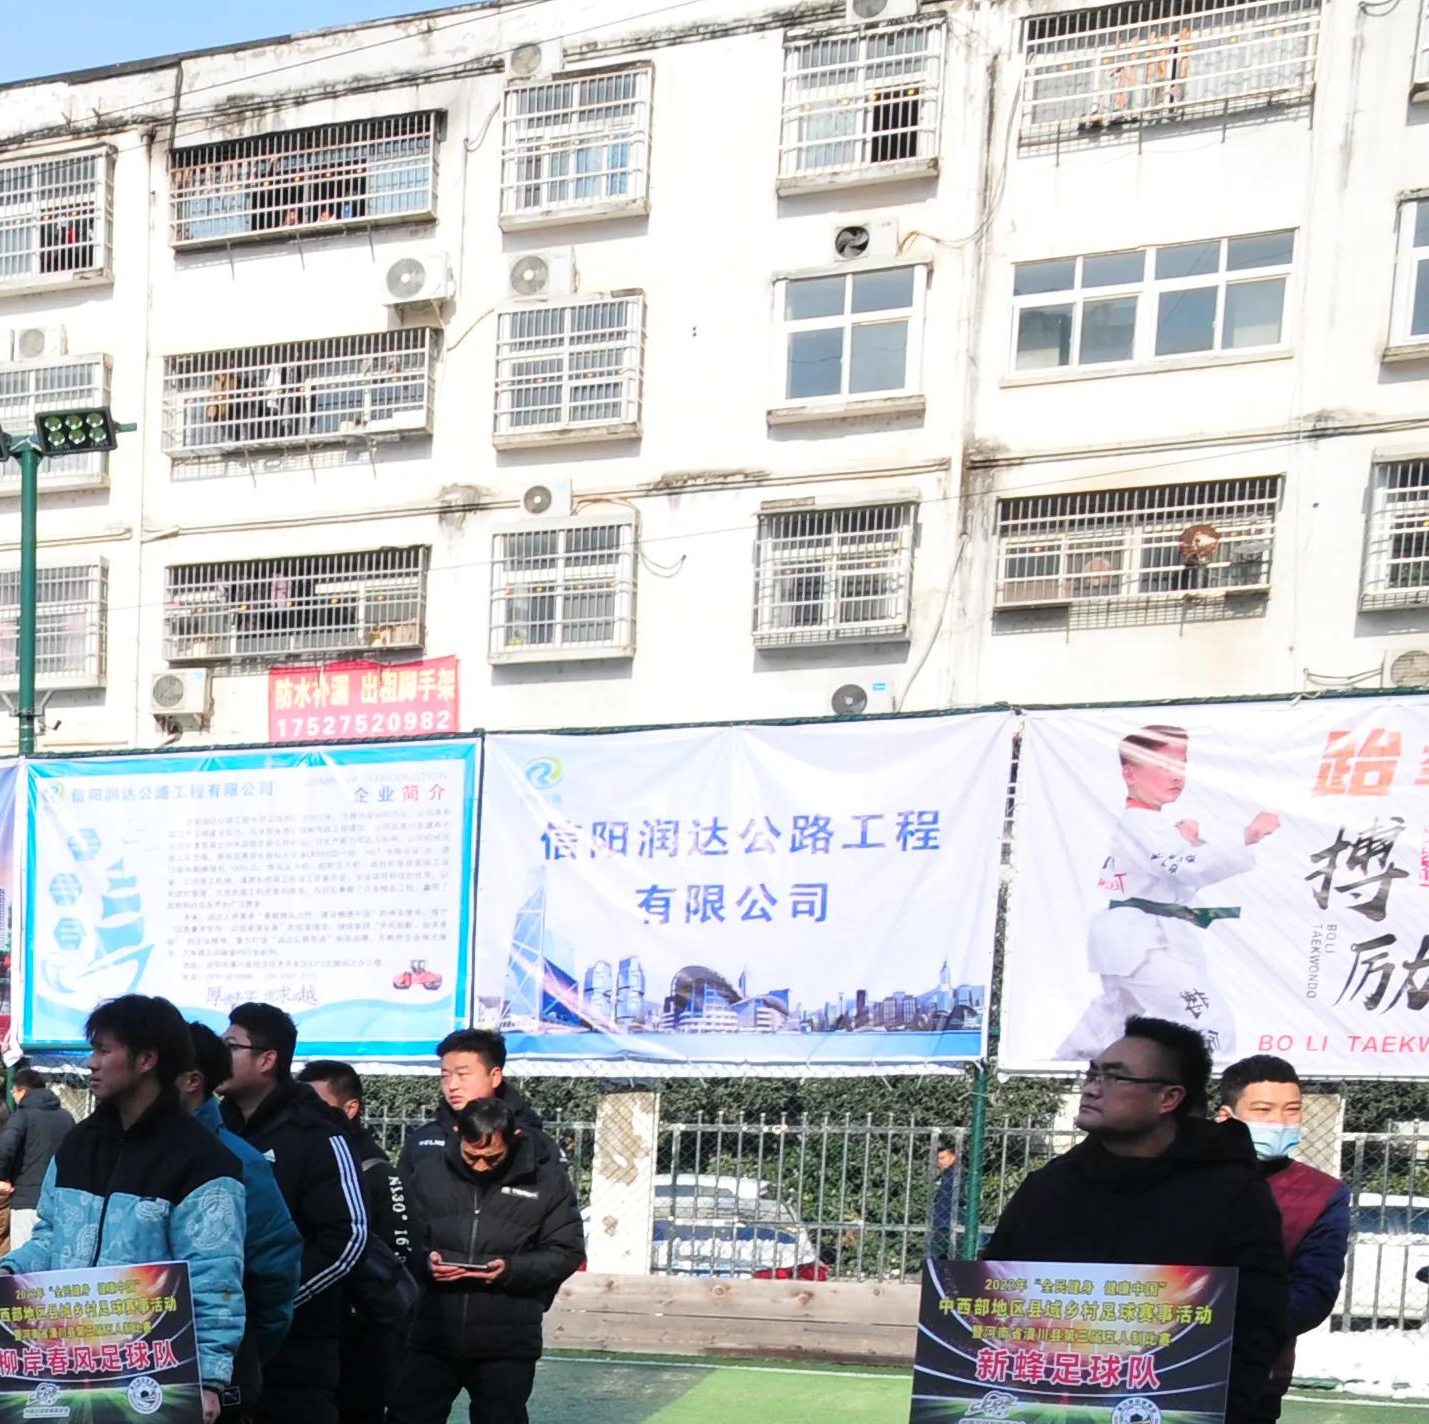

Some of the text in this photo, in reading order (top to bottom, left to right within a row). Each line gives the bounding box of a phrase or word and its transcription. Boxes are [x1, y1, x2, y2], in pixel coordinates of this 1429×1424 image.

[274, 668, 457, 709] 防水补漏 出租脚手架
[276, 710, 451, 738] 17527520982
[71, 780, 275, 803] 信阳润达公路工程有限公司
[353, 783, 448, 804] 企业简介
[541, 809, 942, 861] 信阳润达公路工程
[635, 882, 830, 924] 有限公司
[1257, 1034, 1294, 1052] BO
[1307, 1035, 1328, 1052] LI
[938, 1296, 1214, 1326] 中西部地区县域乡村足球赛事活动
[974, 1347, 1162, 1390] 新蜂足球队
